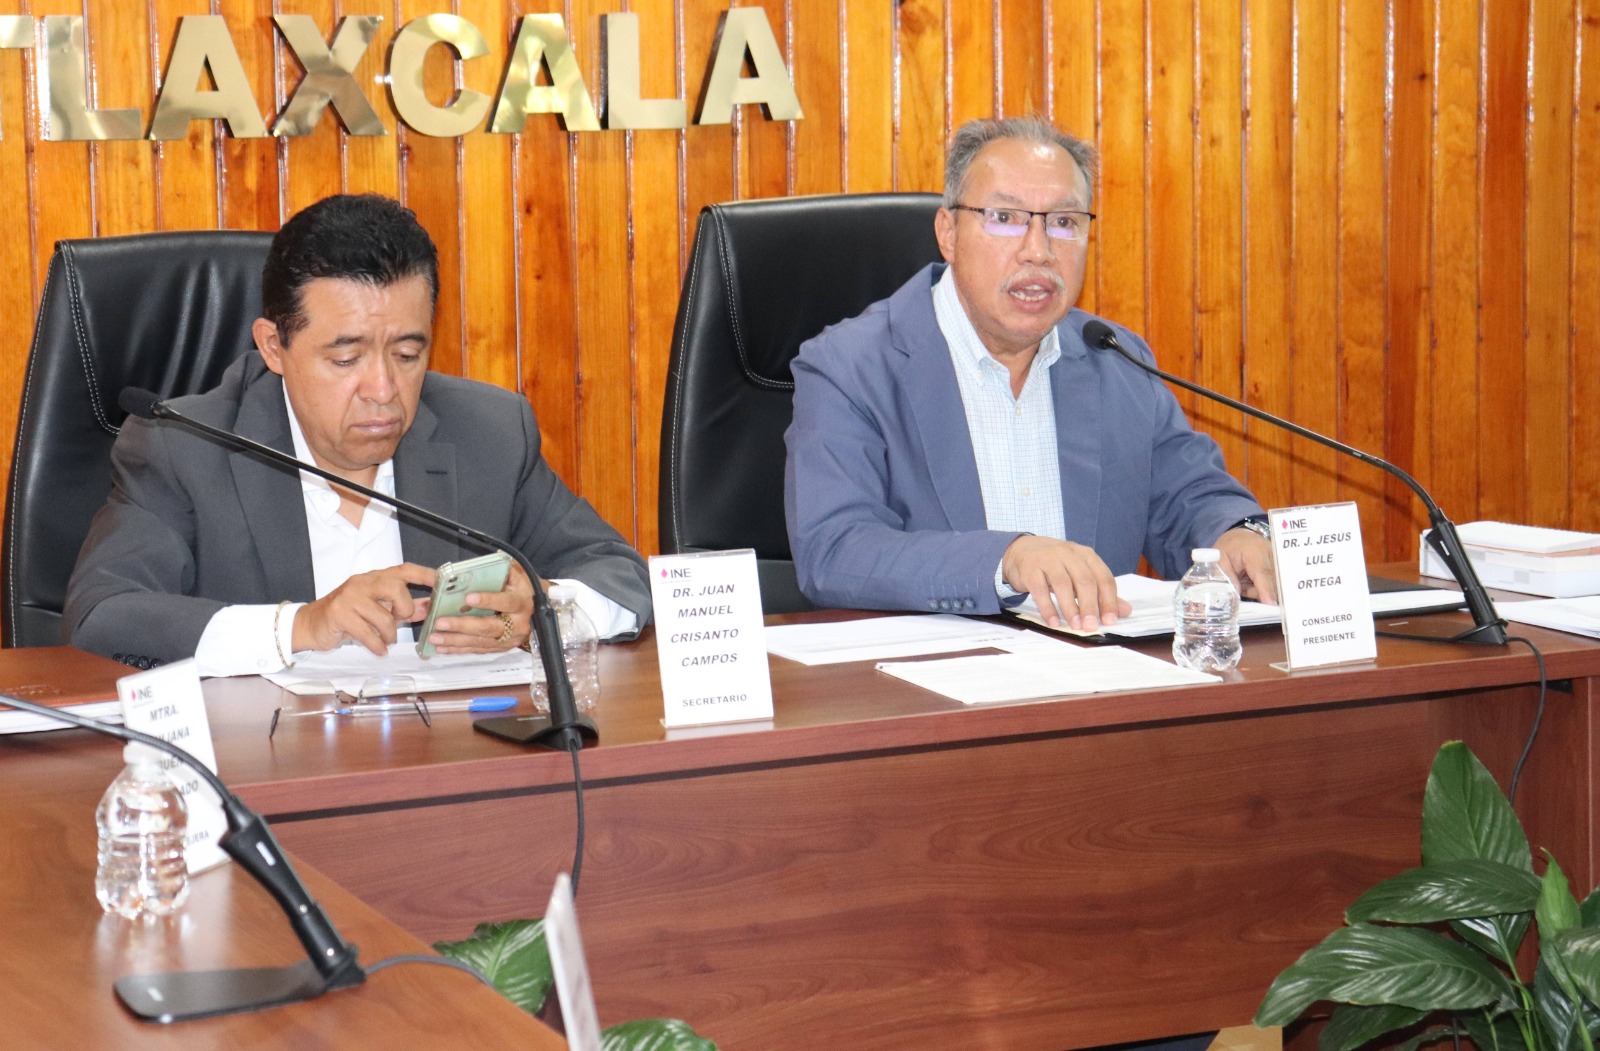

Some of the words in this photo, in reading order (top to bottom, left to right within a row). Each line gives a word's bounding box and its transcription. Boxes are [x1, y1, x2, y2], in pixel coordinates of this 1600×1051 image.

[1290, 518, 1307, 530] INE
[1282, 538, 1300, 549] DR.
[1304, 536, 1313, 547] J.
[1305, 553, 1334, 566] LULE
[670, 567, 692, 579] INE
[1297, 575, 1342, 590] ORTEGA
[672, 587, 694, 599] DR.
[698, 583, 735, 596] JUAN
[677, 604, 734, 618] MANUEL
[1302, 613, 1353, 627] CONSEJERO
[670, 628, 739, 644] CRISANTO
[1303, 631, 1356, 646] PRESIDENTE
[681, 652, 738, 667] CAMPOS
[137, 685, 153, 701] INE
[682, 693, 747, 707] SECRETARIO
[149, 704, 180, 722] MTRA.
